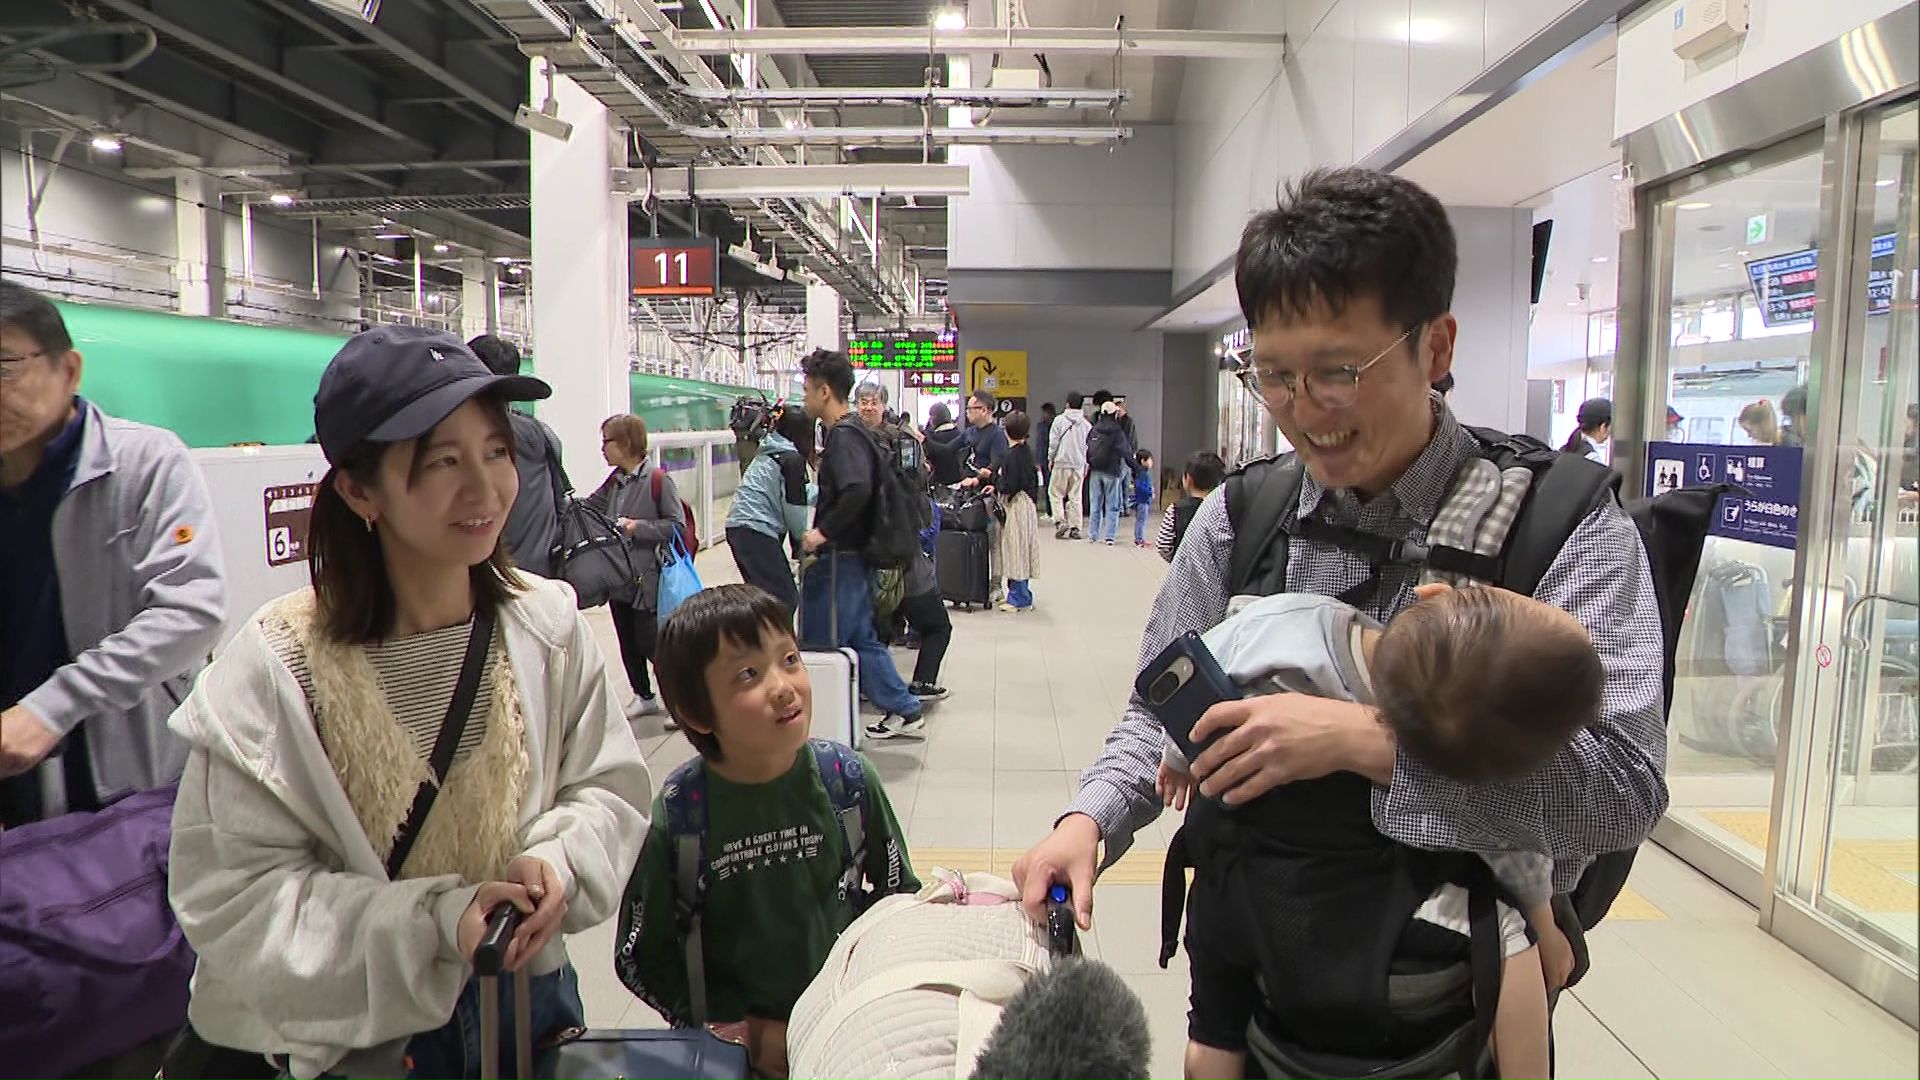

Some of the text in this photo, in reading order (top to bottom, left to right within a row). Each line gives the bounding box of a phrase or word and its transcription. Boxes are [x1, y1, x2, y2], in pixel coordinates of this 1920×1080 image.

[655, 252, 687, 285] 11
[275, 531, 286, 556] 6
[723, 825, 809, 852] HAVE A GREAT TIME IN
[765, 839, 799, 854] CLOTHES
[800, 833, 824, 847] TODAY
[886, 838, 900, 888] CLOTHES
